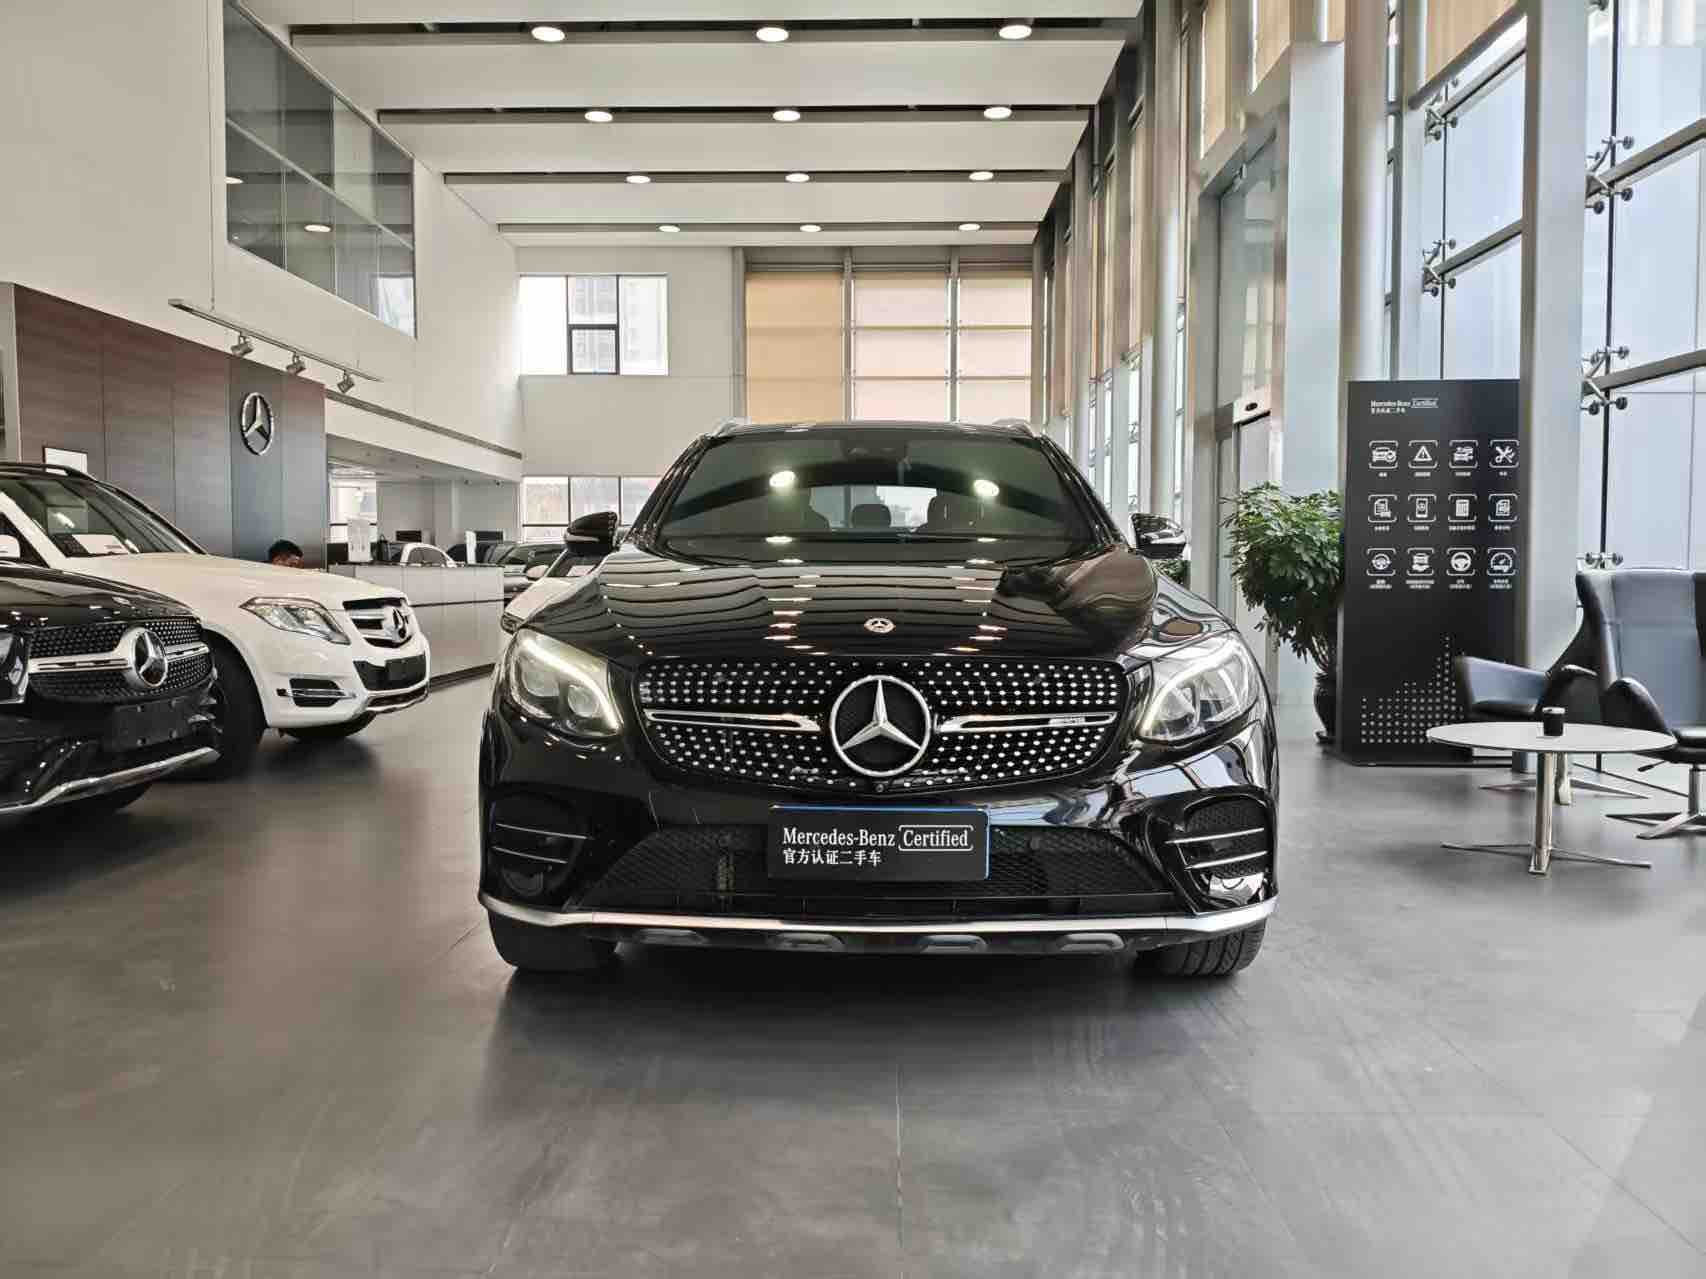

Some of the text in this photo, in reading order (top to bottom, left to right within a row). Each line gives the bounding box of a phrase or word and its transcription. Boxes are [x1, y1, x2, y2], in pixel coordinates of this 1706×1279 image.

[782, 827, 969, 847] Mercedes-Benz Certified
[783, 848, 882, 866] 官方认证二手车
